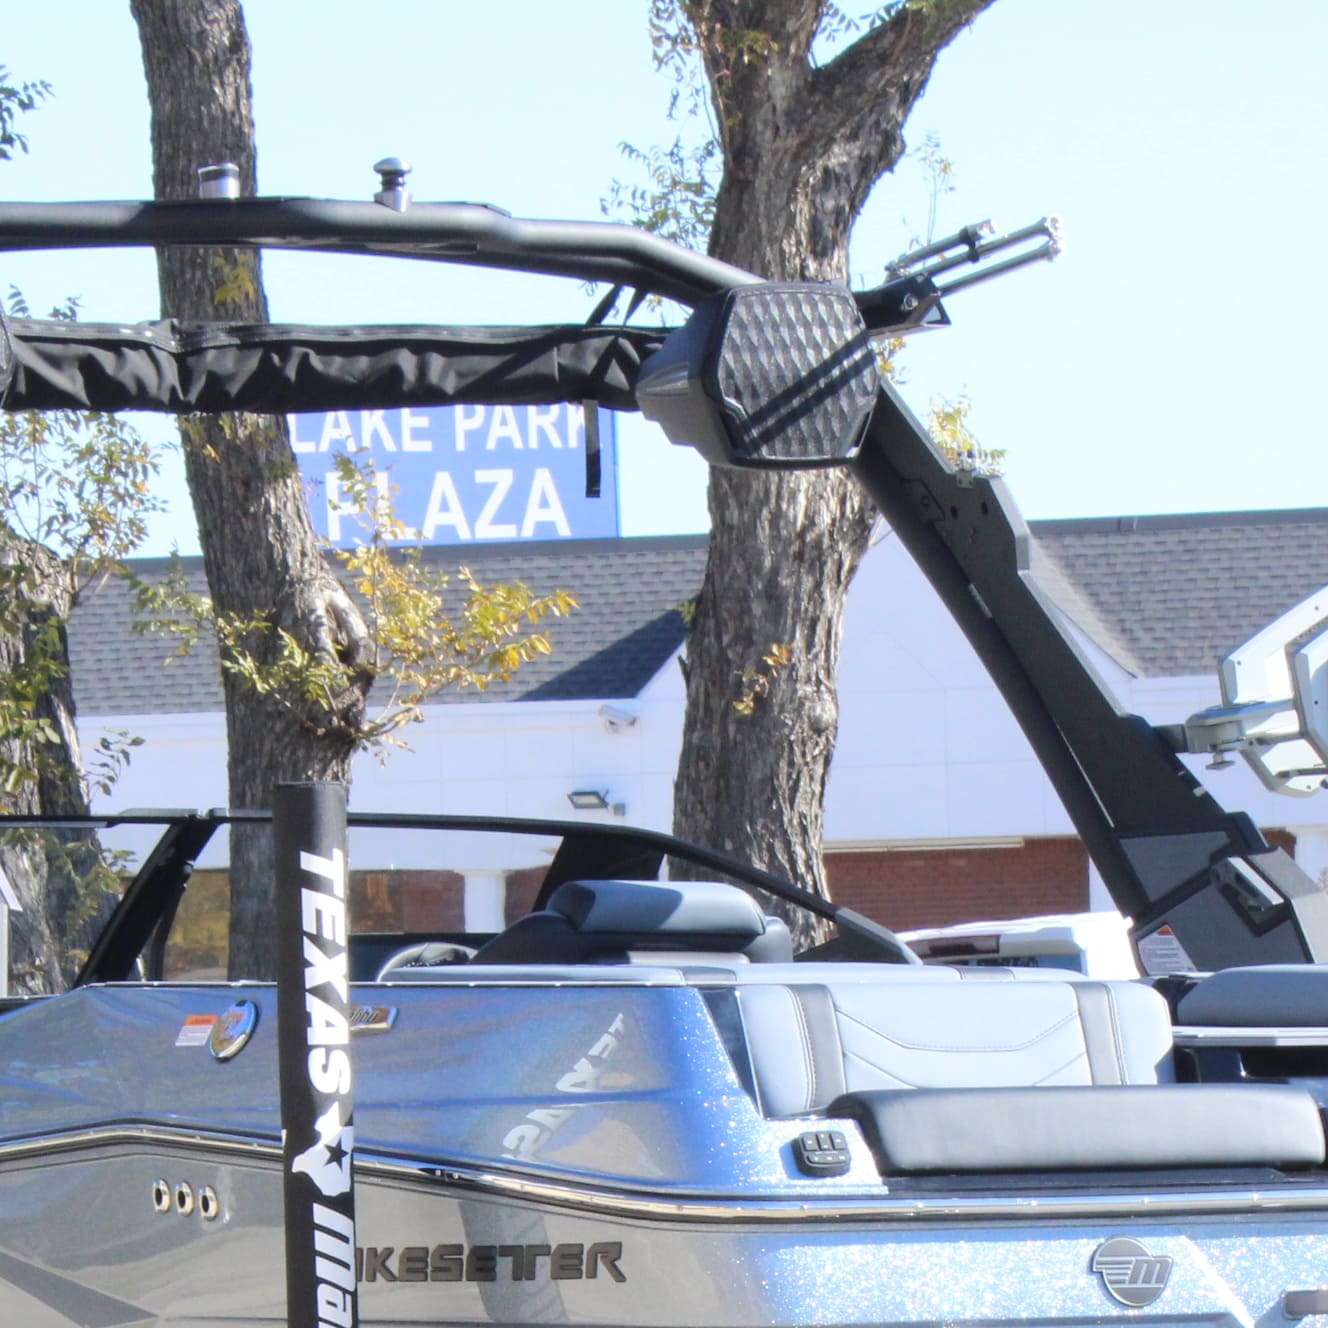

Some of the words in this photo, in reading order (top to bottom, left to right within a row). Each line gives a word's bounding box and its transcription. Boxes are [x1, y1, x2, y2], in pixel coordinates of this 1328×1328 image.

[285, 408, 433, 453] LAKE
[455, 404, 603, 451] PARK
[325, 468, 572, 541] PLAZA
[299, 848, 351, 1094] TEXAS
[356, 1241, 627, 1283] KESETTER
